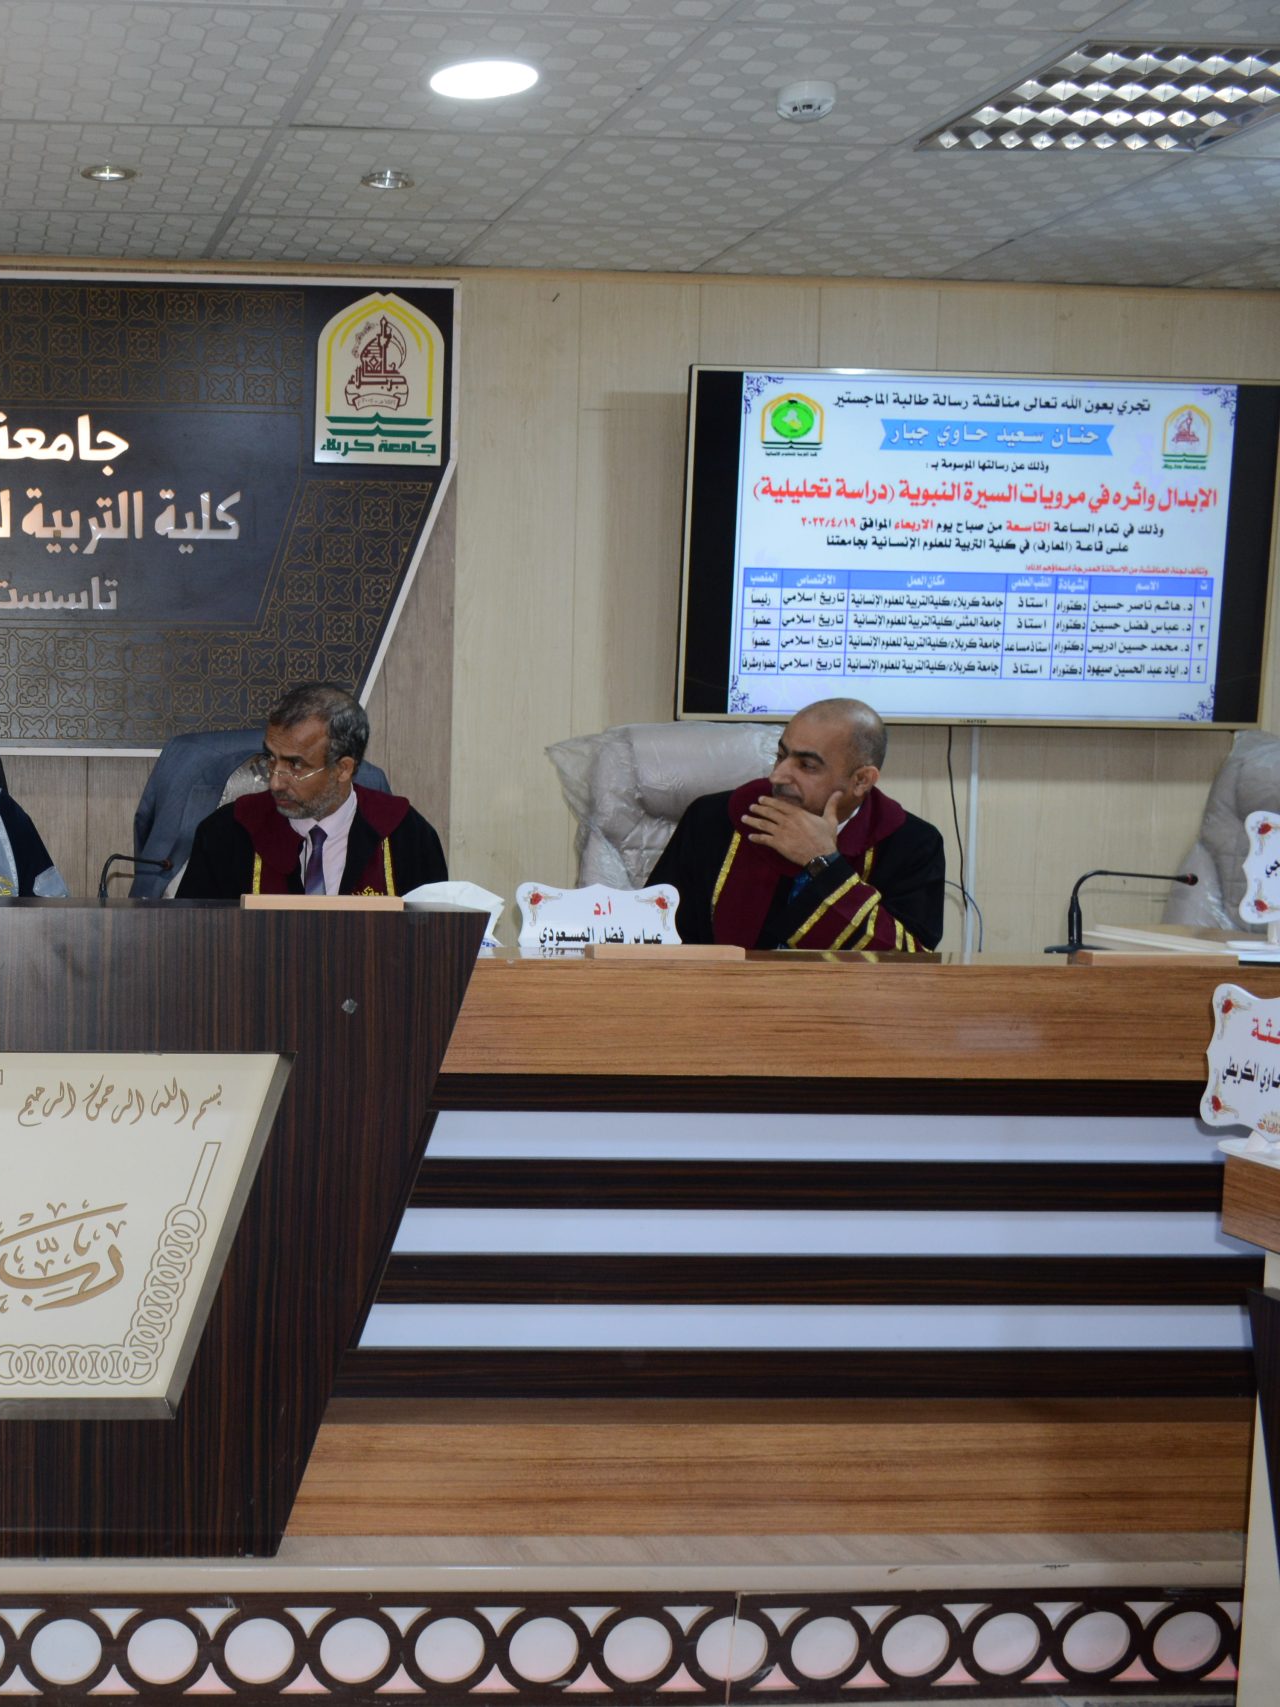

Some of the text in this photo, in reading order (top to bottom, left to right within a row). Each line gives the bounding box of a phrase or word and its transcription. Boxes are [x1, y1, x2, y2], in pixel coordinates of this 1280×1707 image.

[833, 392, 1150, 415] تجري بعون الله تعالى مناقشة رسالة طالبة الماجستير
[890, 422, 1099, 448] حنان سعيد حاوي جبار
[320, 438, 436, 456] جامعة كربلاء
[942, 458, 974, 471] الموسومة
[978, 459, 1008, 472] رسالتها
[1011, 462, 1024, 473] عن
[1028, 461, 1049, 473] وذلك
[753, 476, 1217, 513] الإبدال واثره في مرويات السيرة النبوية (دراسة تحليلية)
[22, 487, 144, 555] التربية
[155, 489, 241, 554] كلية
[860, 517, 892, 531] الموافق
[894, 518, 934, 531] الاربعاء
[936, 521, 952, 533] يوم
[956, 520, 984, 534] صباح
[987, 521, 1002, 534] من
[1006, 519, 1050, 532] التاسعة
[1054, 521, 1094, 534] الساعة
[1098, 522, 1119, 537] تمام
[1123, 523, 1134, 537] في
[1138, 522, 1164, 537] وذلك
[826, 535, 1129, 555] على قاعة (المعارف) في كلية التربية للعلوم الإنسانية بجامعتنا
[783, 592, 845, 605] تاريخ اسلامي
[1018, 596, 1048, 608] استاذ
[1093, 600, 1193, 613] د. هاشم ناصر حسين
[782, 614, 844, 627] تاريخ اسلامي
[1016, 618, 1047, 629] استاذ
[1090, 620, 1192, 634] د. عباس فضل حسين
[780, 635, 843, 648] تاريخ اسلامي
[1004, 640, 1051, 652] استاذ مساعد
[1088, 641, 1190, 654] د. محمد حسين ادريس
[780, 658, 842, 671] تاريخ اسلامي
[1012, 662, 1042, 674] استاذ
[1086, 664, 1189, 678] د. اياد عبد الحسين صيهود
[538, 926, 594, 948] المسعودي
[600, 926, 624, 944] فضل
[18, 1074, 223, 1131] بسم الله الرحمن الرحيم
